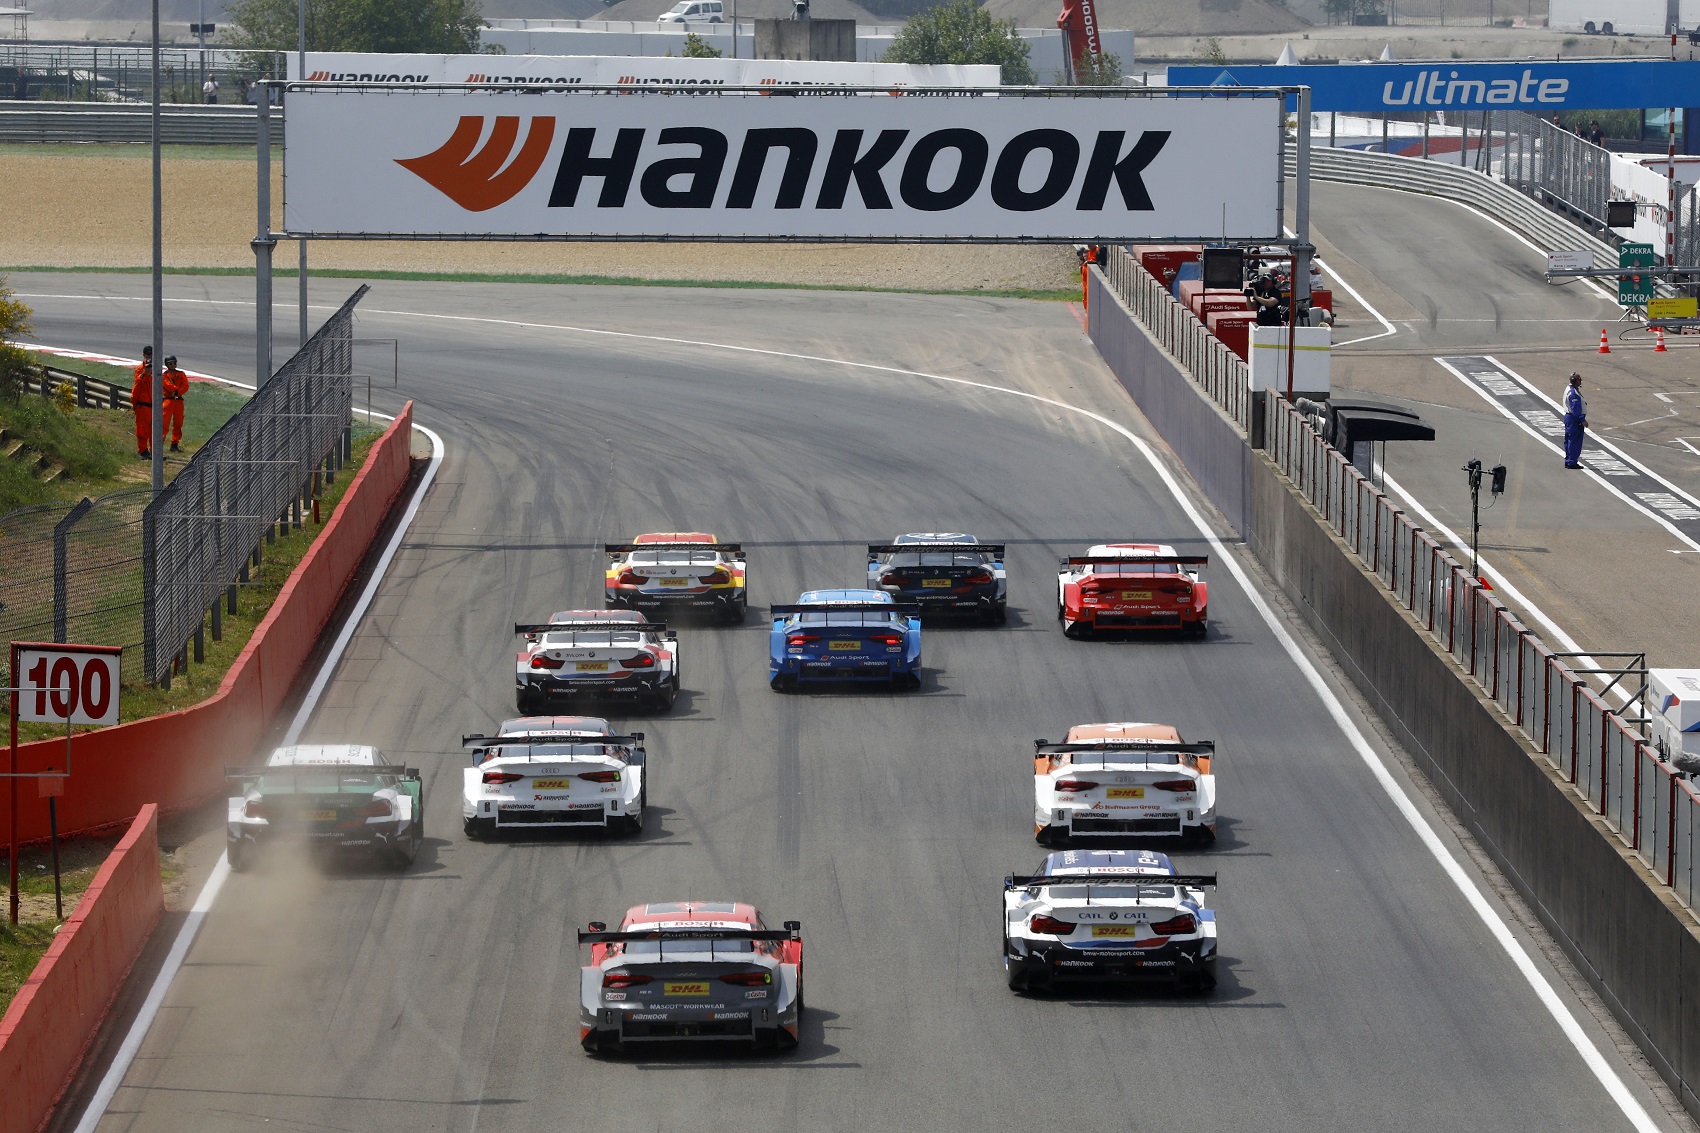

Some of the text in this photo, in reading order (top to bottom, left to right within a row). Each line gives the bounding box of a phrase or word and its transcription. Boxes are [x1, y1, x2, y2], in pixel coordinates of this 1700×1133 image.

[1382, 69, 1570, 105] ultimate
[1630, 247, 1652, 255] DEKRA
[1620, 294, 1651, 303] DEKRA
[29, 657, 111, 720] 100
[671, 985, 704, 993] DHL
